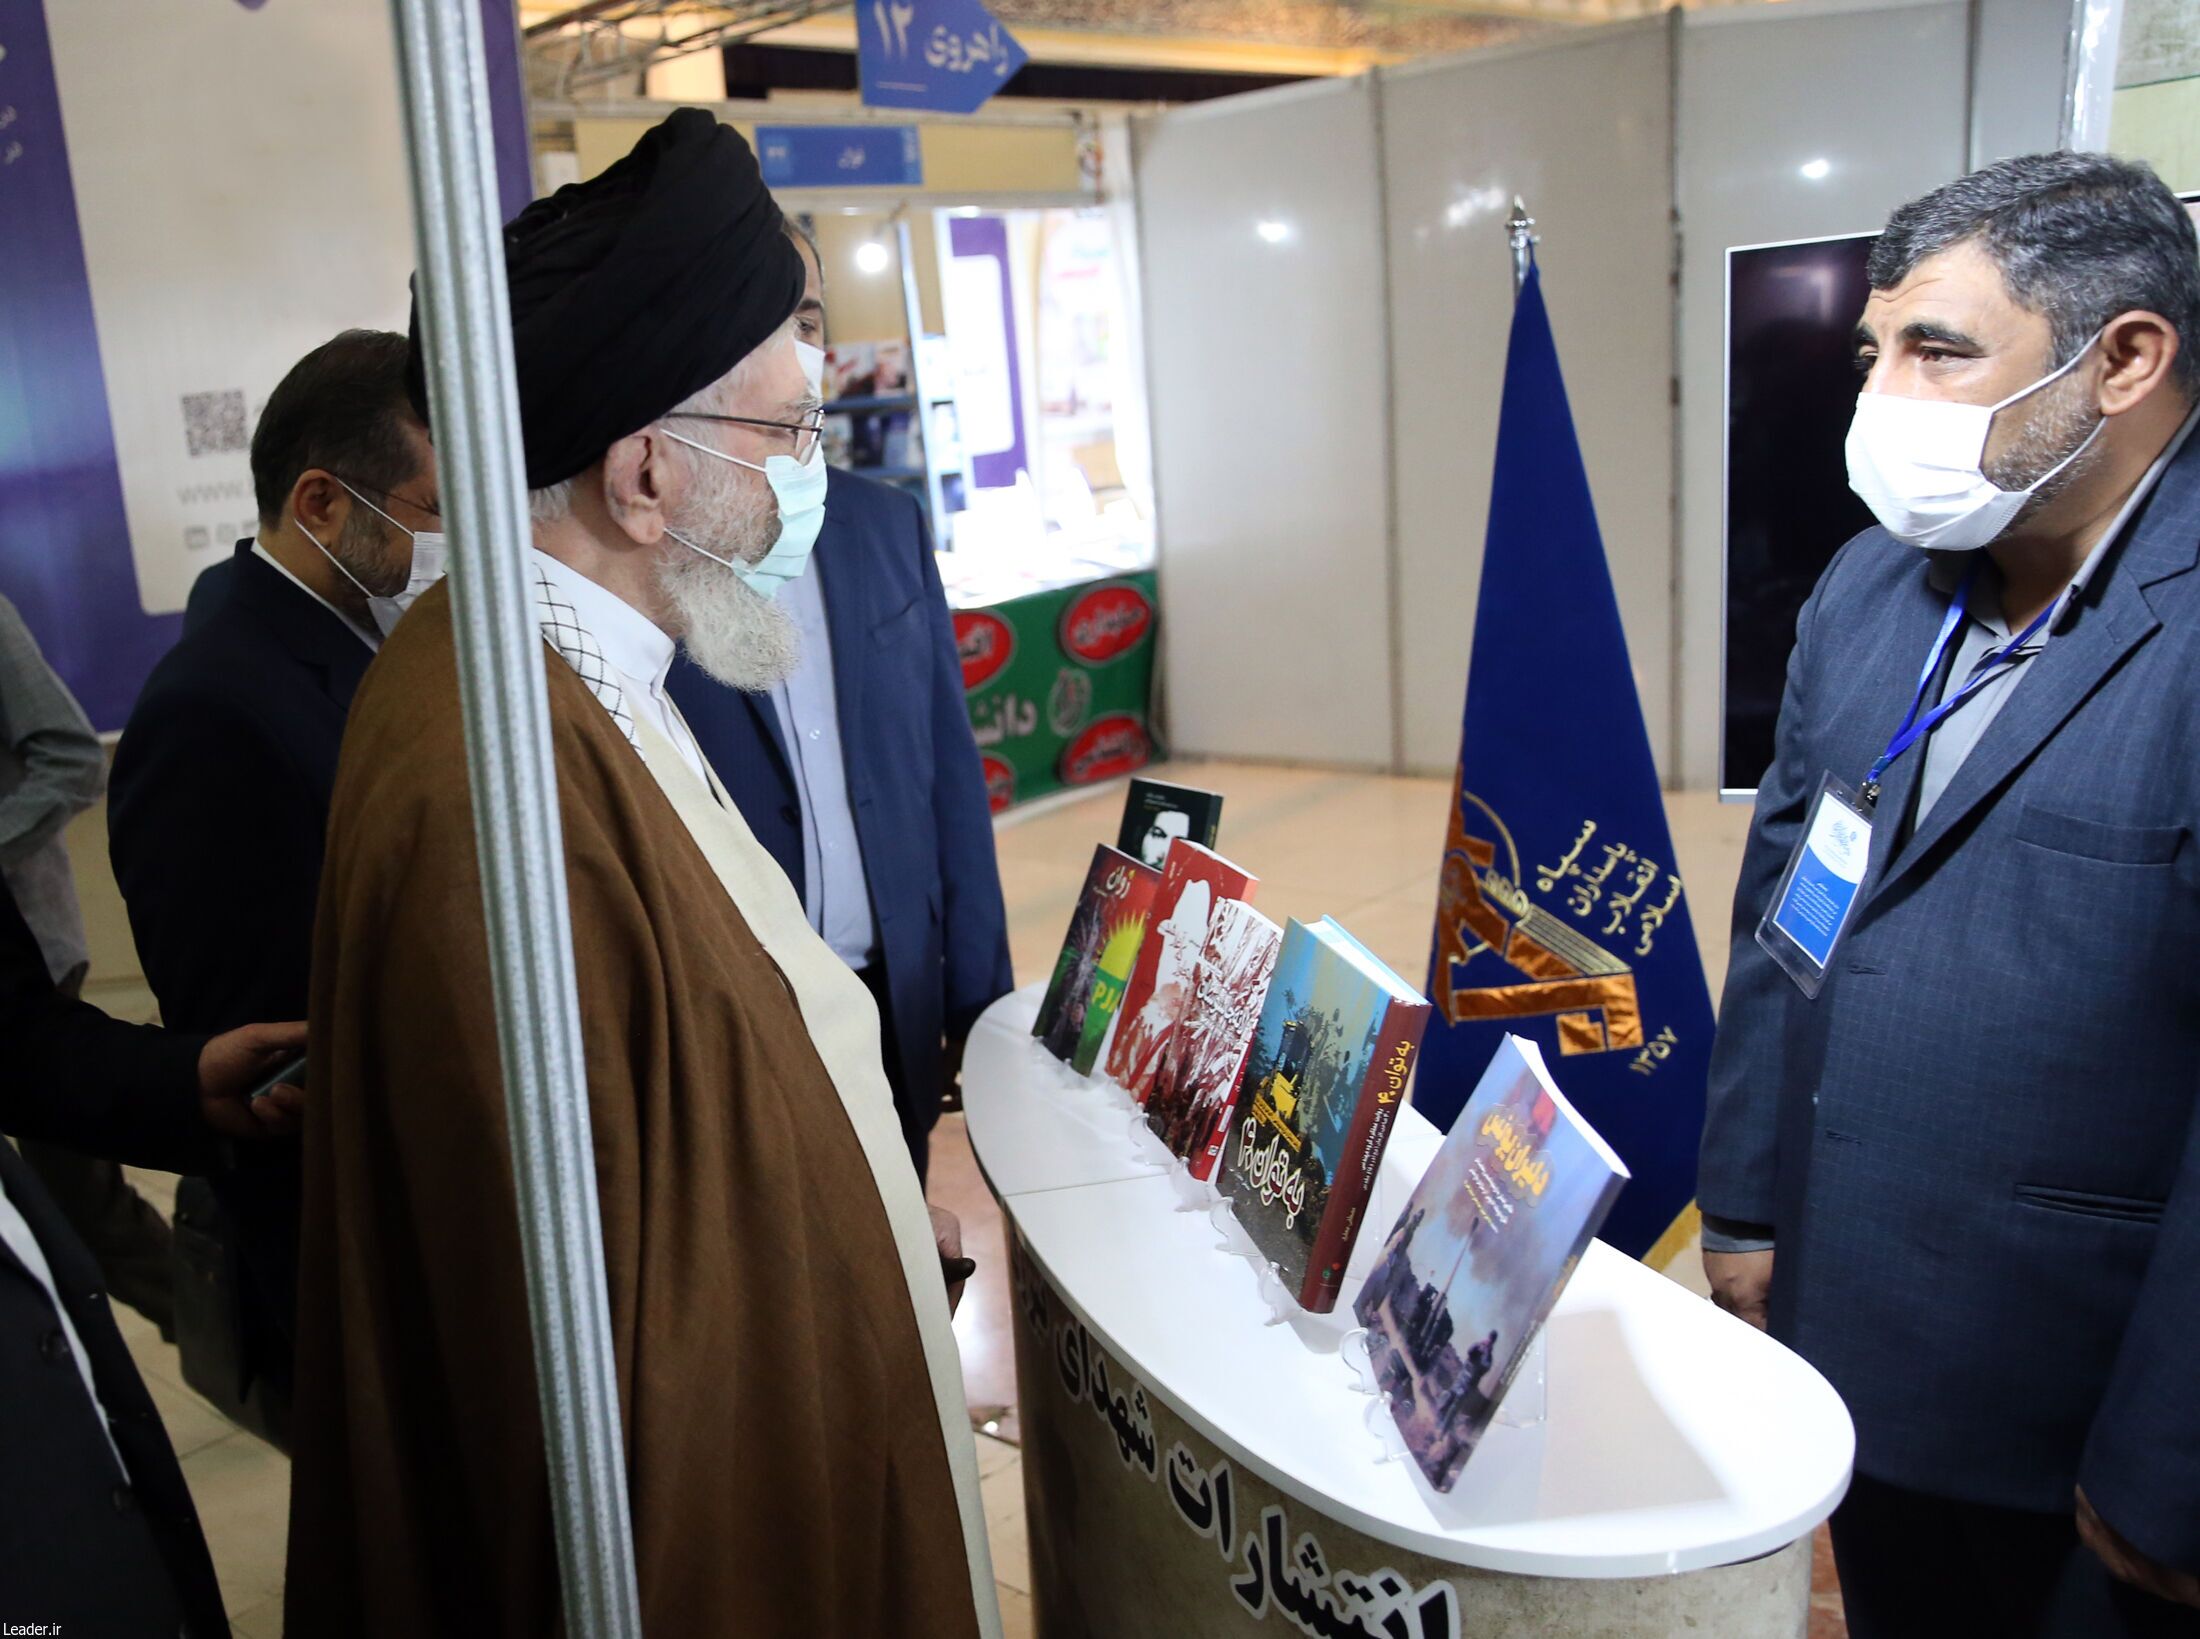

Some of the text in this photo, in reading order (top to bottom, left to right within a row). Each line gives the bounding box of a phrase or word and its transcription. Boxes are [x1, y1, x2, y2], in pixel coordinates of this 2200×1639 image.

[925, 23, 1010, 77] راهروی
[1537, 820, 1597, 892] سپاه
[1567, 842, 1638, 917] پاسداران
[1602, 857, 1660, 935] انقلاب
[1383, 1056, 1408, 1090] توان
[1395, 1039, 1415, 1058] به
[1629, 1025, 1679, 1077] ۱۳۵۷
[1055, 1321, 1457, 1639] انتشارات شهدای
